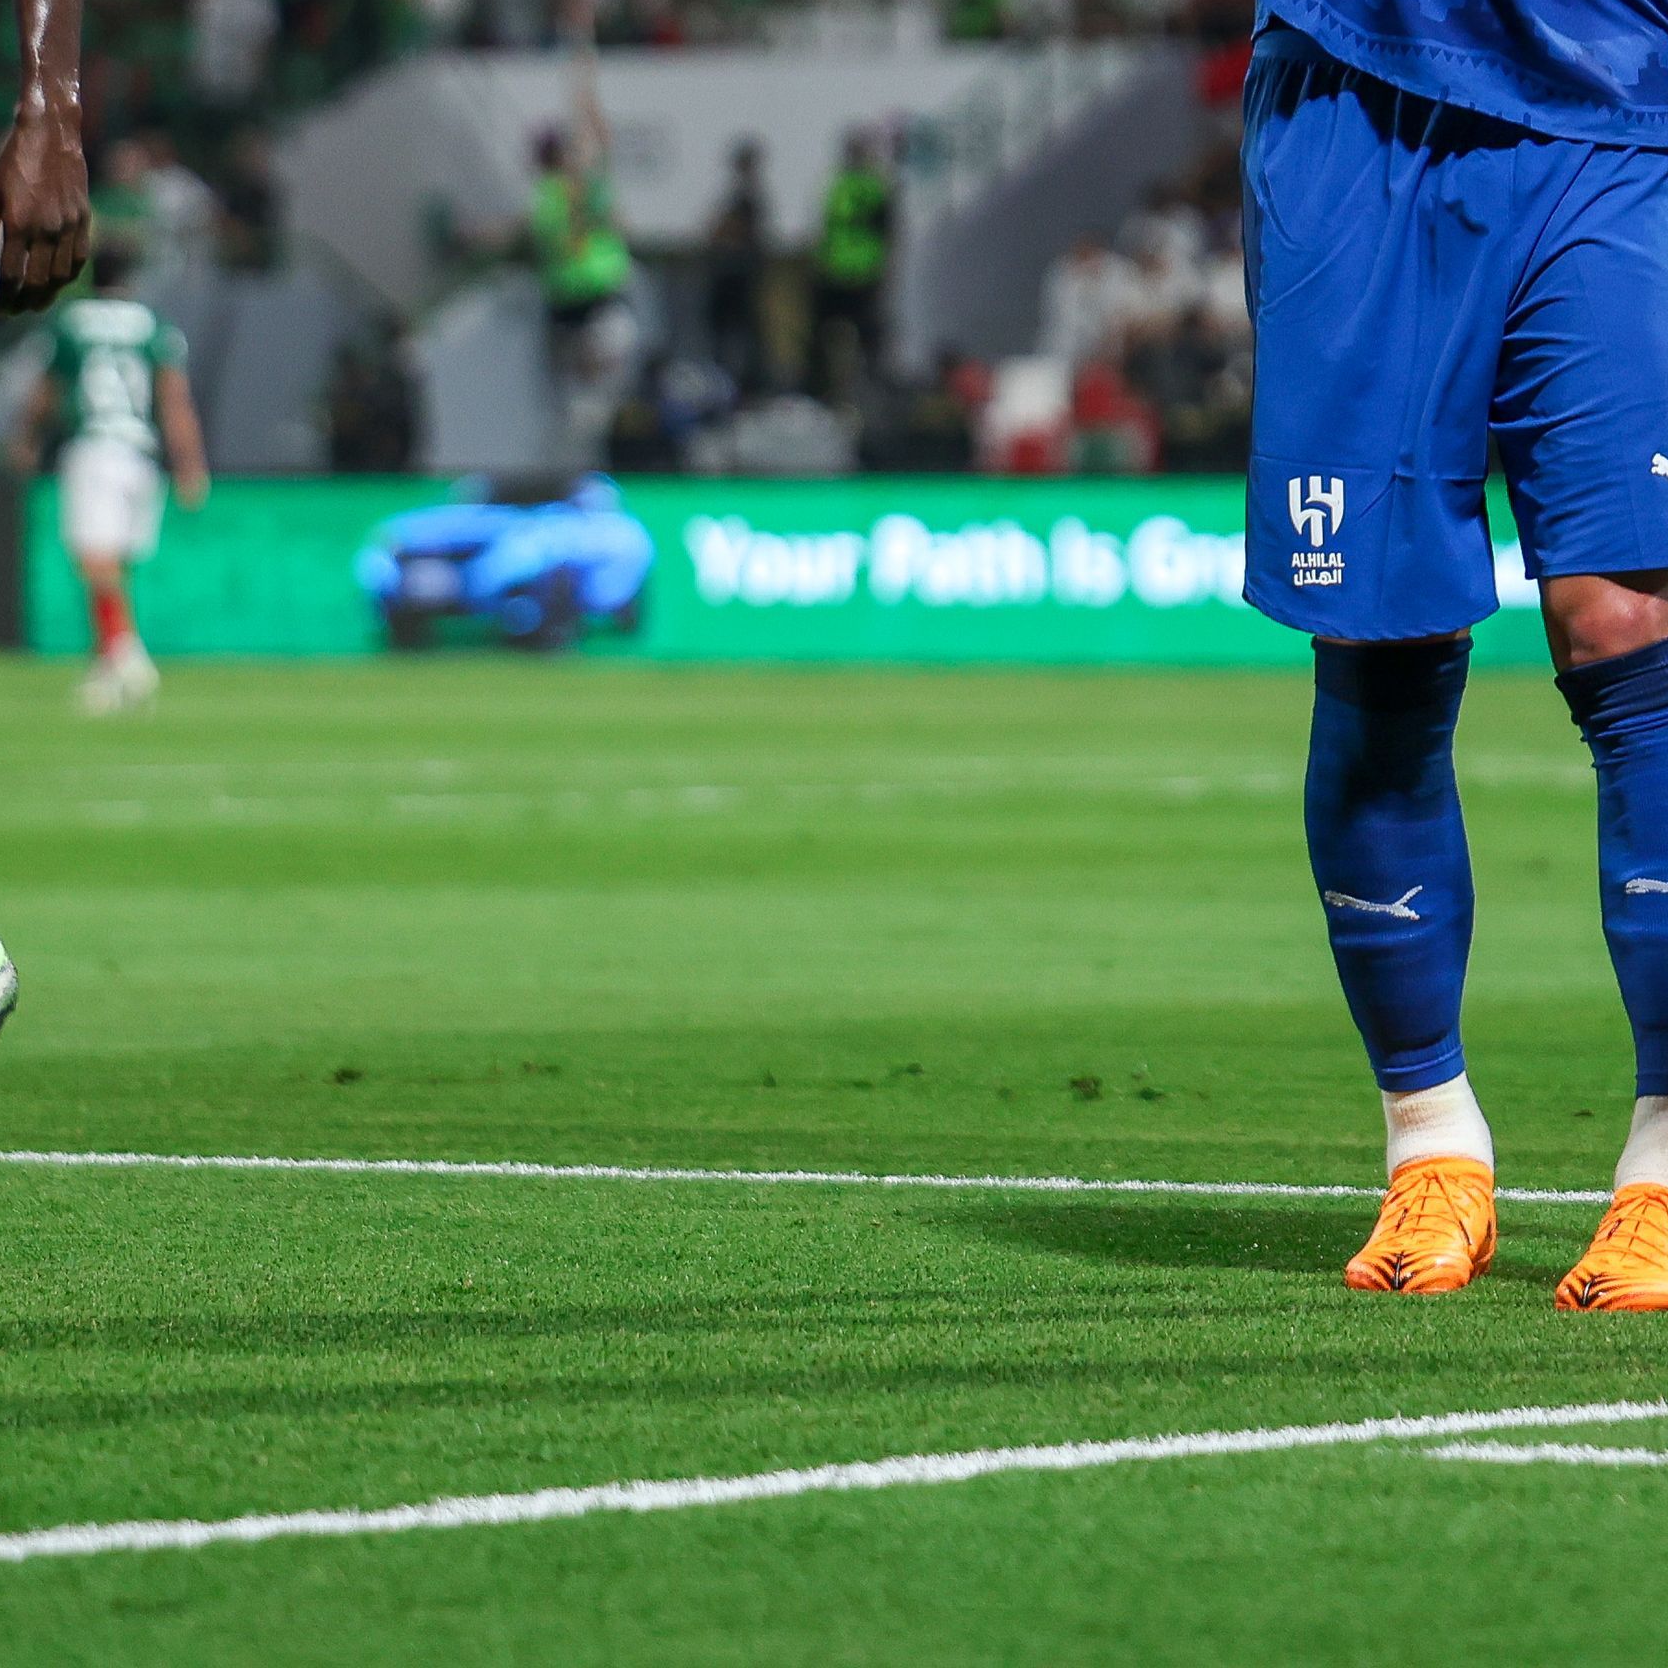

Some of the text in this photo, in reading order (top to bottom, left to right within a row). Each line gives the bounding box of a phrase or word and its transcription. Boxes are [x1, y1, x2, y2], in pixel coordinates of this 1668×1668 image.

[686, 514, 865, 608] Your
[869, 513, 1048, 608] Path
[1291, 552, 1346, 568] ALHILAL
[1293, 568, 1343, 587] الهلال
